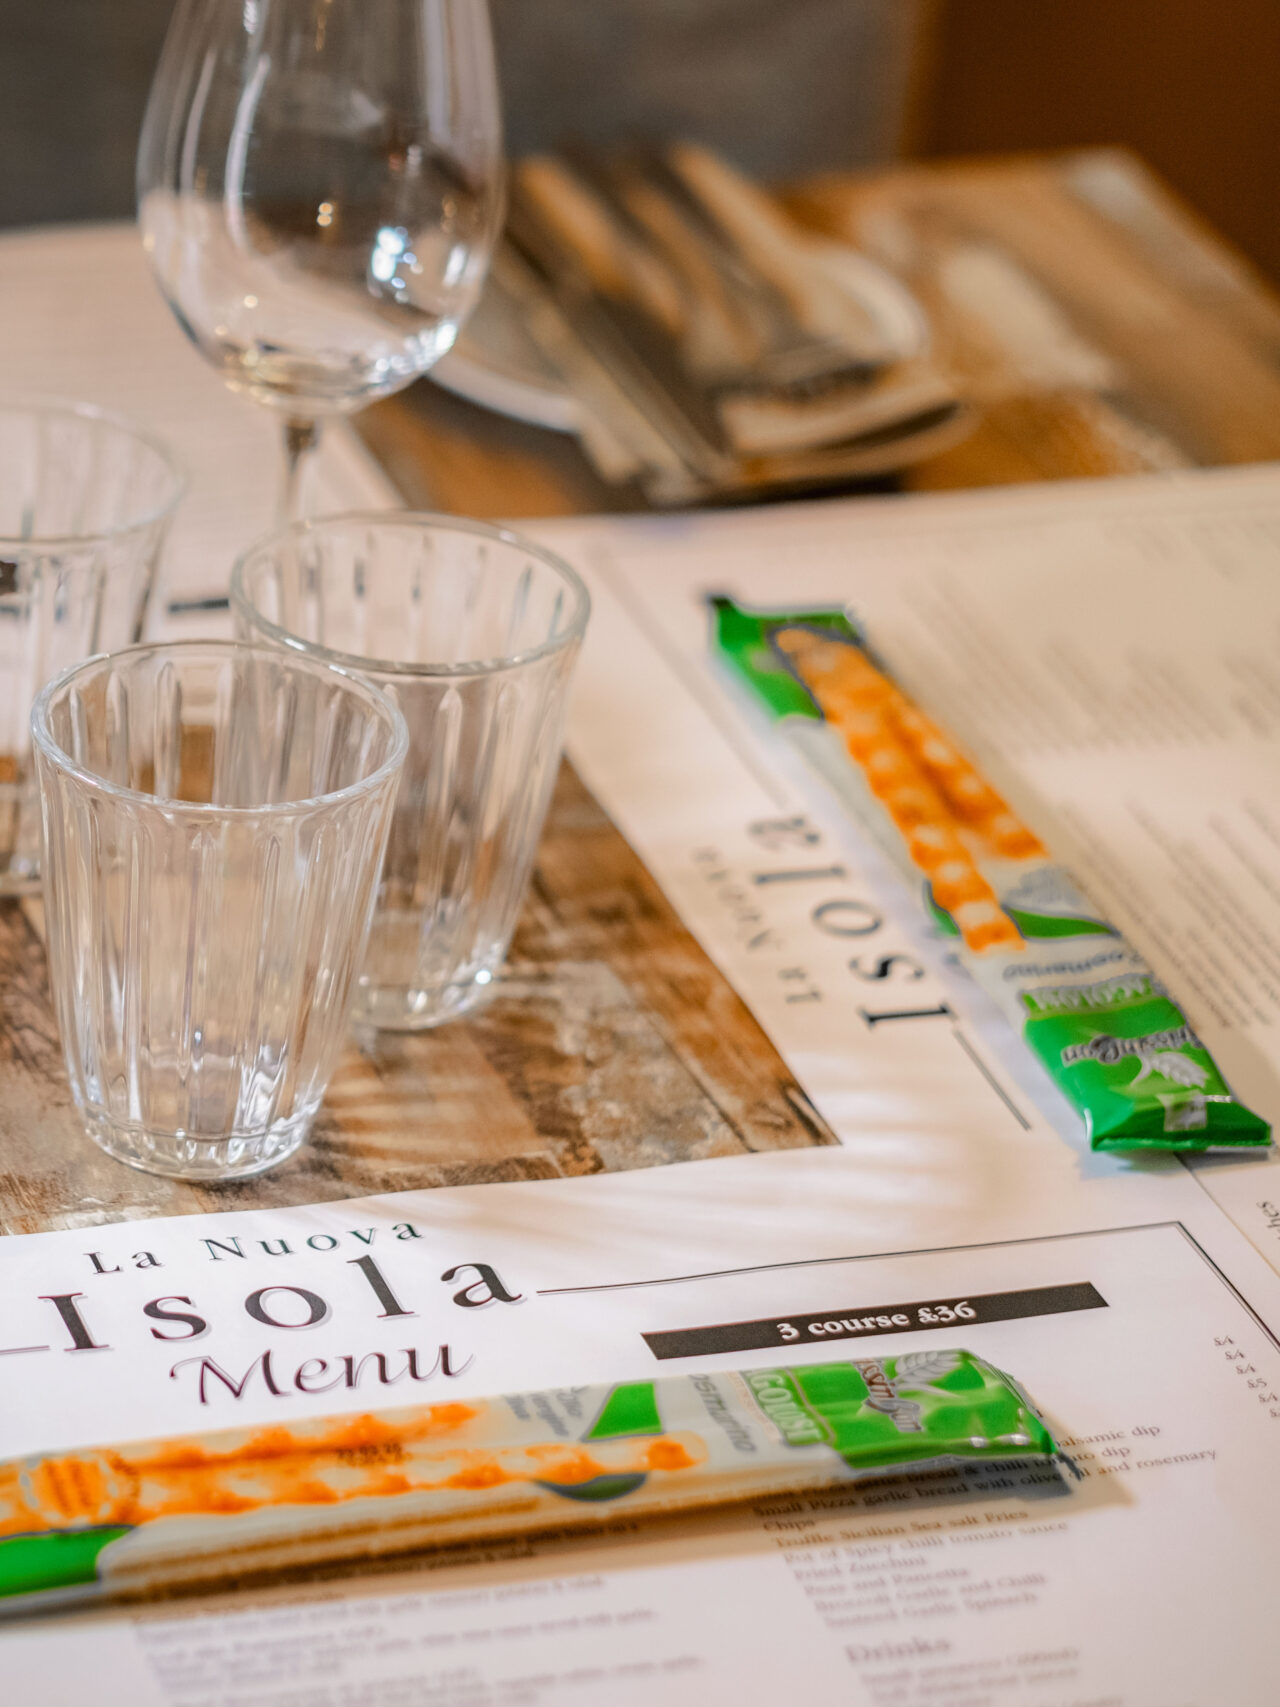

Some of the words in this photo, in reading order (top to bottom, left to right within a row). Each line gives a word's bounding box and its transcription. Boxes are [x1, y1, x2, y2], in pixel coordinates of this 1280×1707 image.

[747, 813, 958, 1031] Isola
[84, 1248, 164, 1275] La
[200, 1221, 424, 1262] Nuova
[38, 1254, 526, 1352] Isola
[777, 1322, 800, 1341] 3
[808, 1313, 910, 1336] course
[917, 1301, 977, 1324] £36
[169, 1343, 474, 1405] Menu
[1102, 1445, 1131, 1458] dip
[1132, 1424, 1161, 1438] dip
[863, 1488, 913, 1507] garlic
[915, 1481, 969, 1499] bread
[974, 1476, 1015, 1491] with
[1020, 1471, 1062, 1487] olive
[1098, 1462, 1131, 1476] and
[1136, 1448, 1218, 1470] rosemary
[763, 1518, 817, 1533] Chips
[983, 1509, 1029, 1524] Fries
